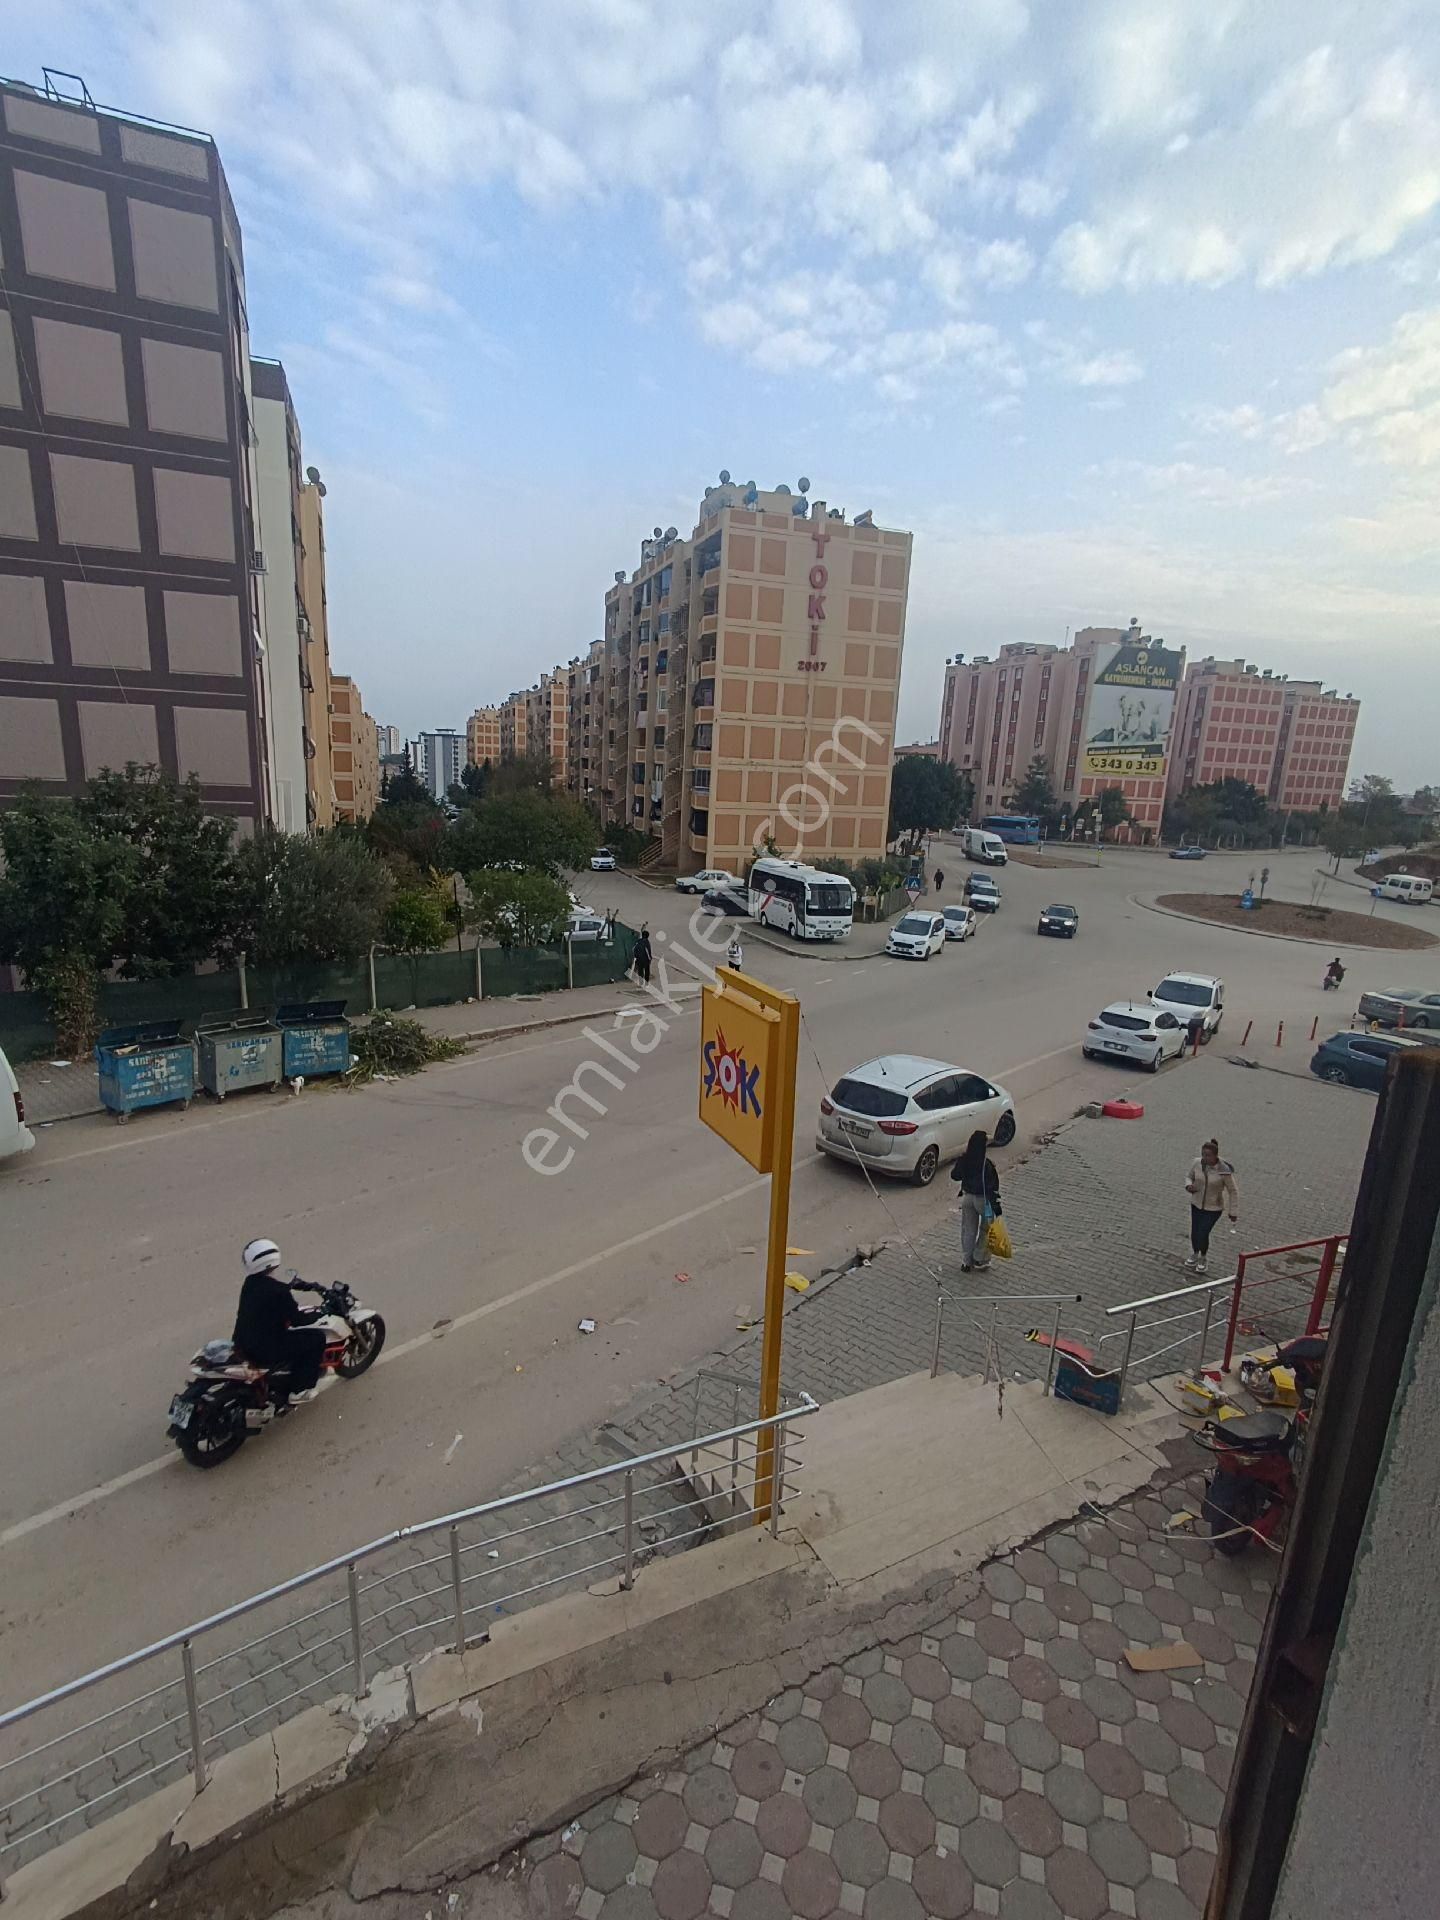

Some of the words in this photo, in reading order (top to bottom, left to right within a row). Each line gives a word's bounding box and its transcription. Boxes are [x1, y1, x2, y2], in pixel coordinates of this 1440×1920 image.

[1115, 663, 1166, 676] ASLANCAN
[1100, 758, 1122, 769] 343
[1125, 761, 1132, 770] 0
[1136, 761, 1157, 771] 343
[703, 1040, 762, 1119] ŞOK
